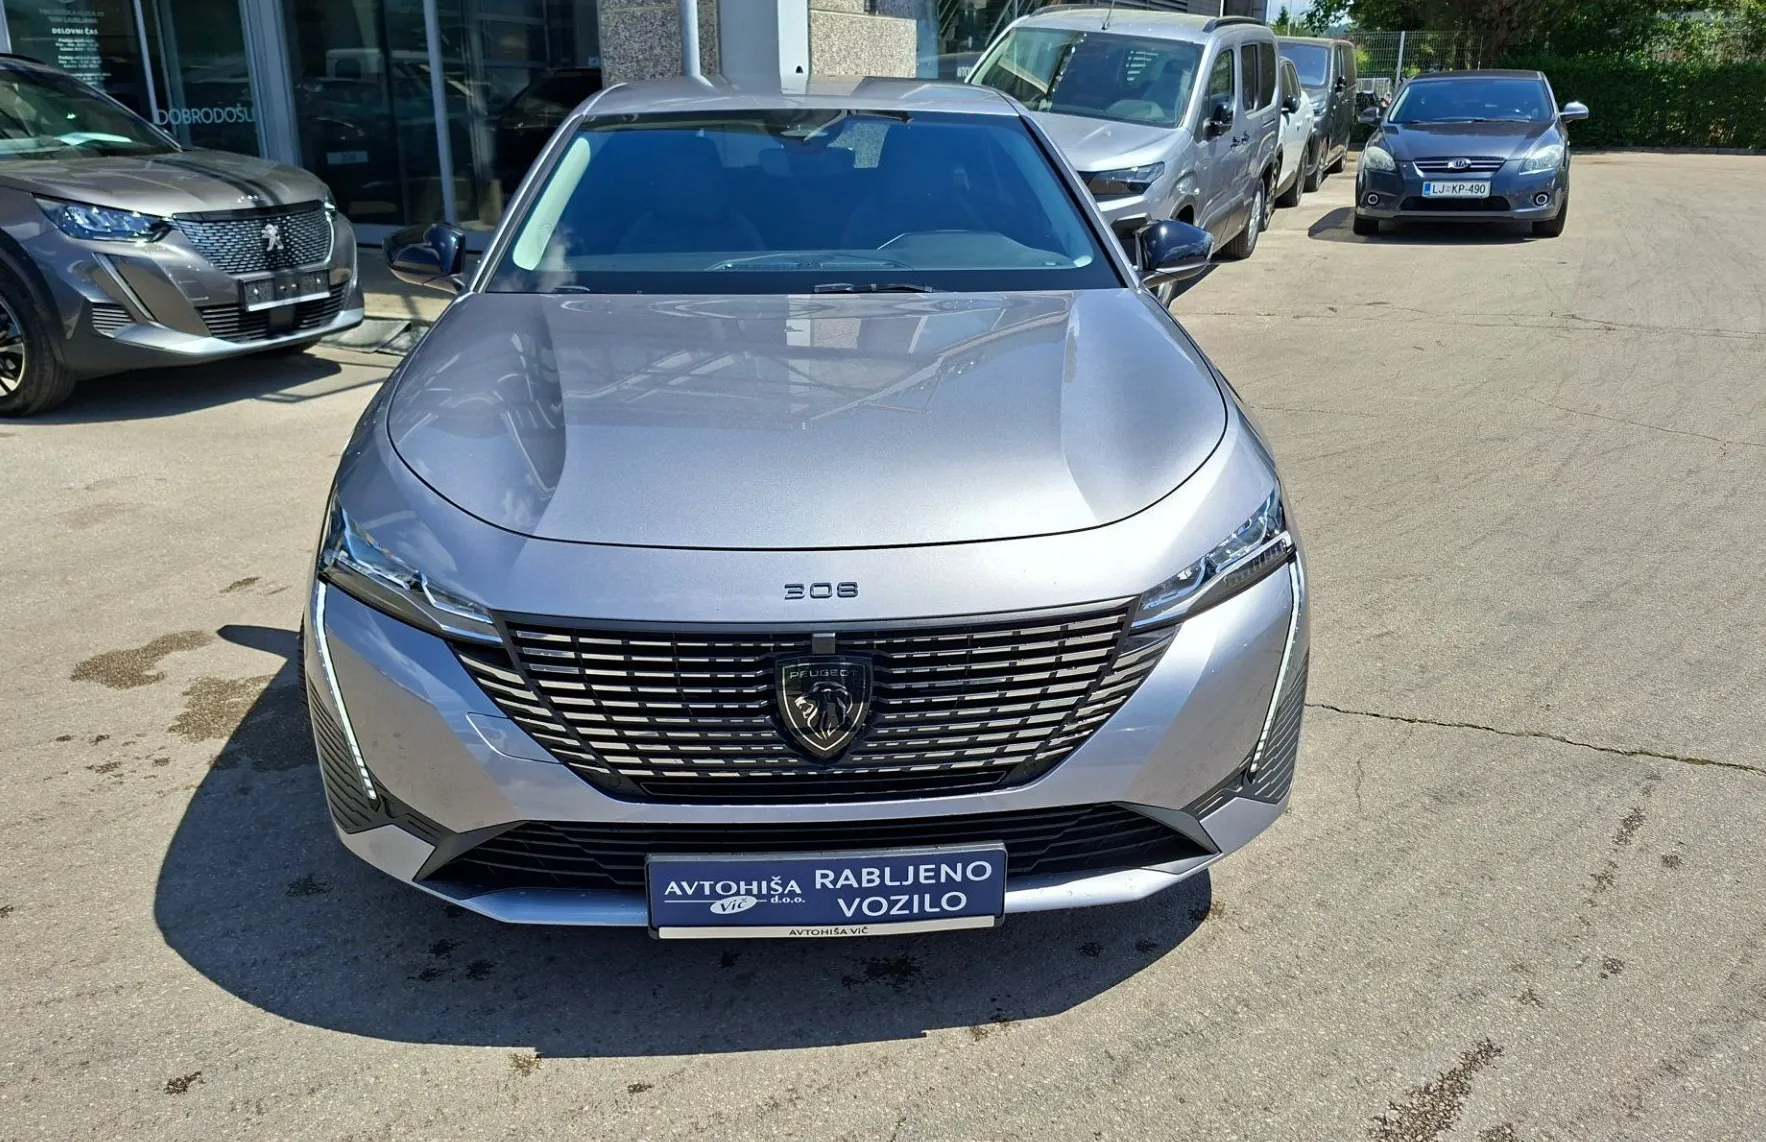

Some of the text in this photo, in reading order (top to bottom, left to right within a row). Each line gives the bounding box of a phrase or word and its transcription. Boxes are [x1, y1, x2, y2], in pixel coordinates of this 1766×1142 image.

[1432, 184, 1486, 194] LJ KP-490
[784, 582, 859, 600] 308
[790, 669, 858, 679] PEUGEOT
[815, 861, 992, 890] RABLJENO
[664, 875, 802, 896] AVTOHIŠA
[719, 895, 806, 913] Vič d.o.o.
[837, 892, 967, 918] VOZILO
[788, 927, 848, 936] AVTOHIŠA
